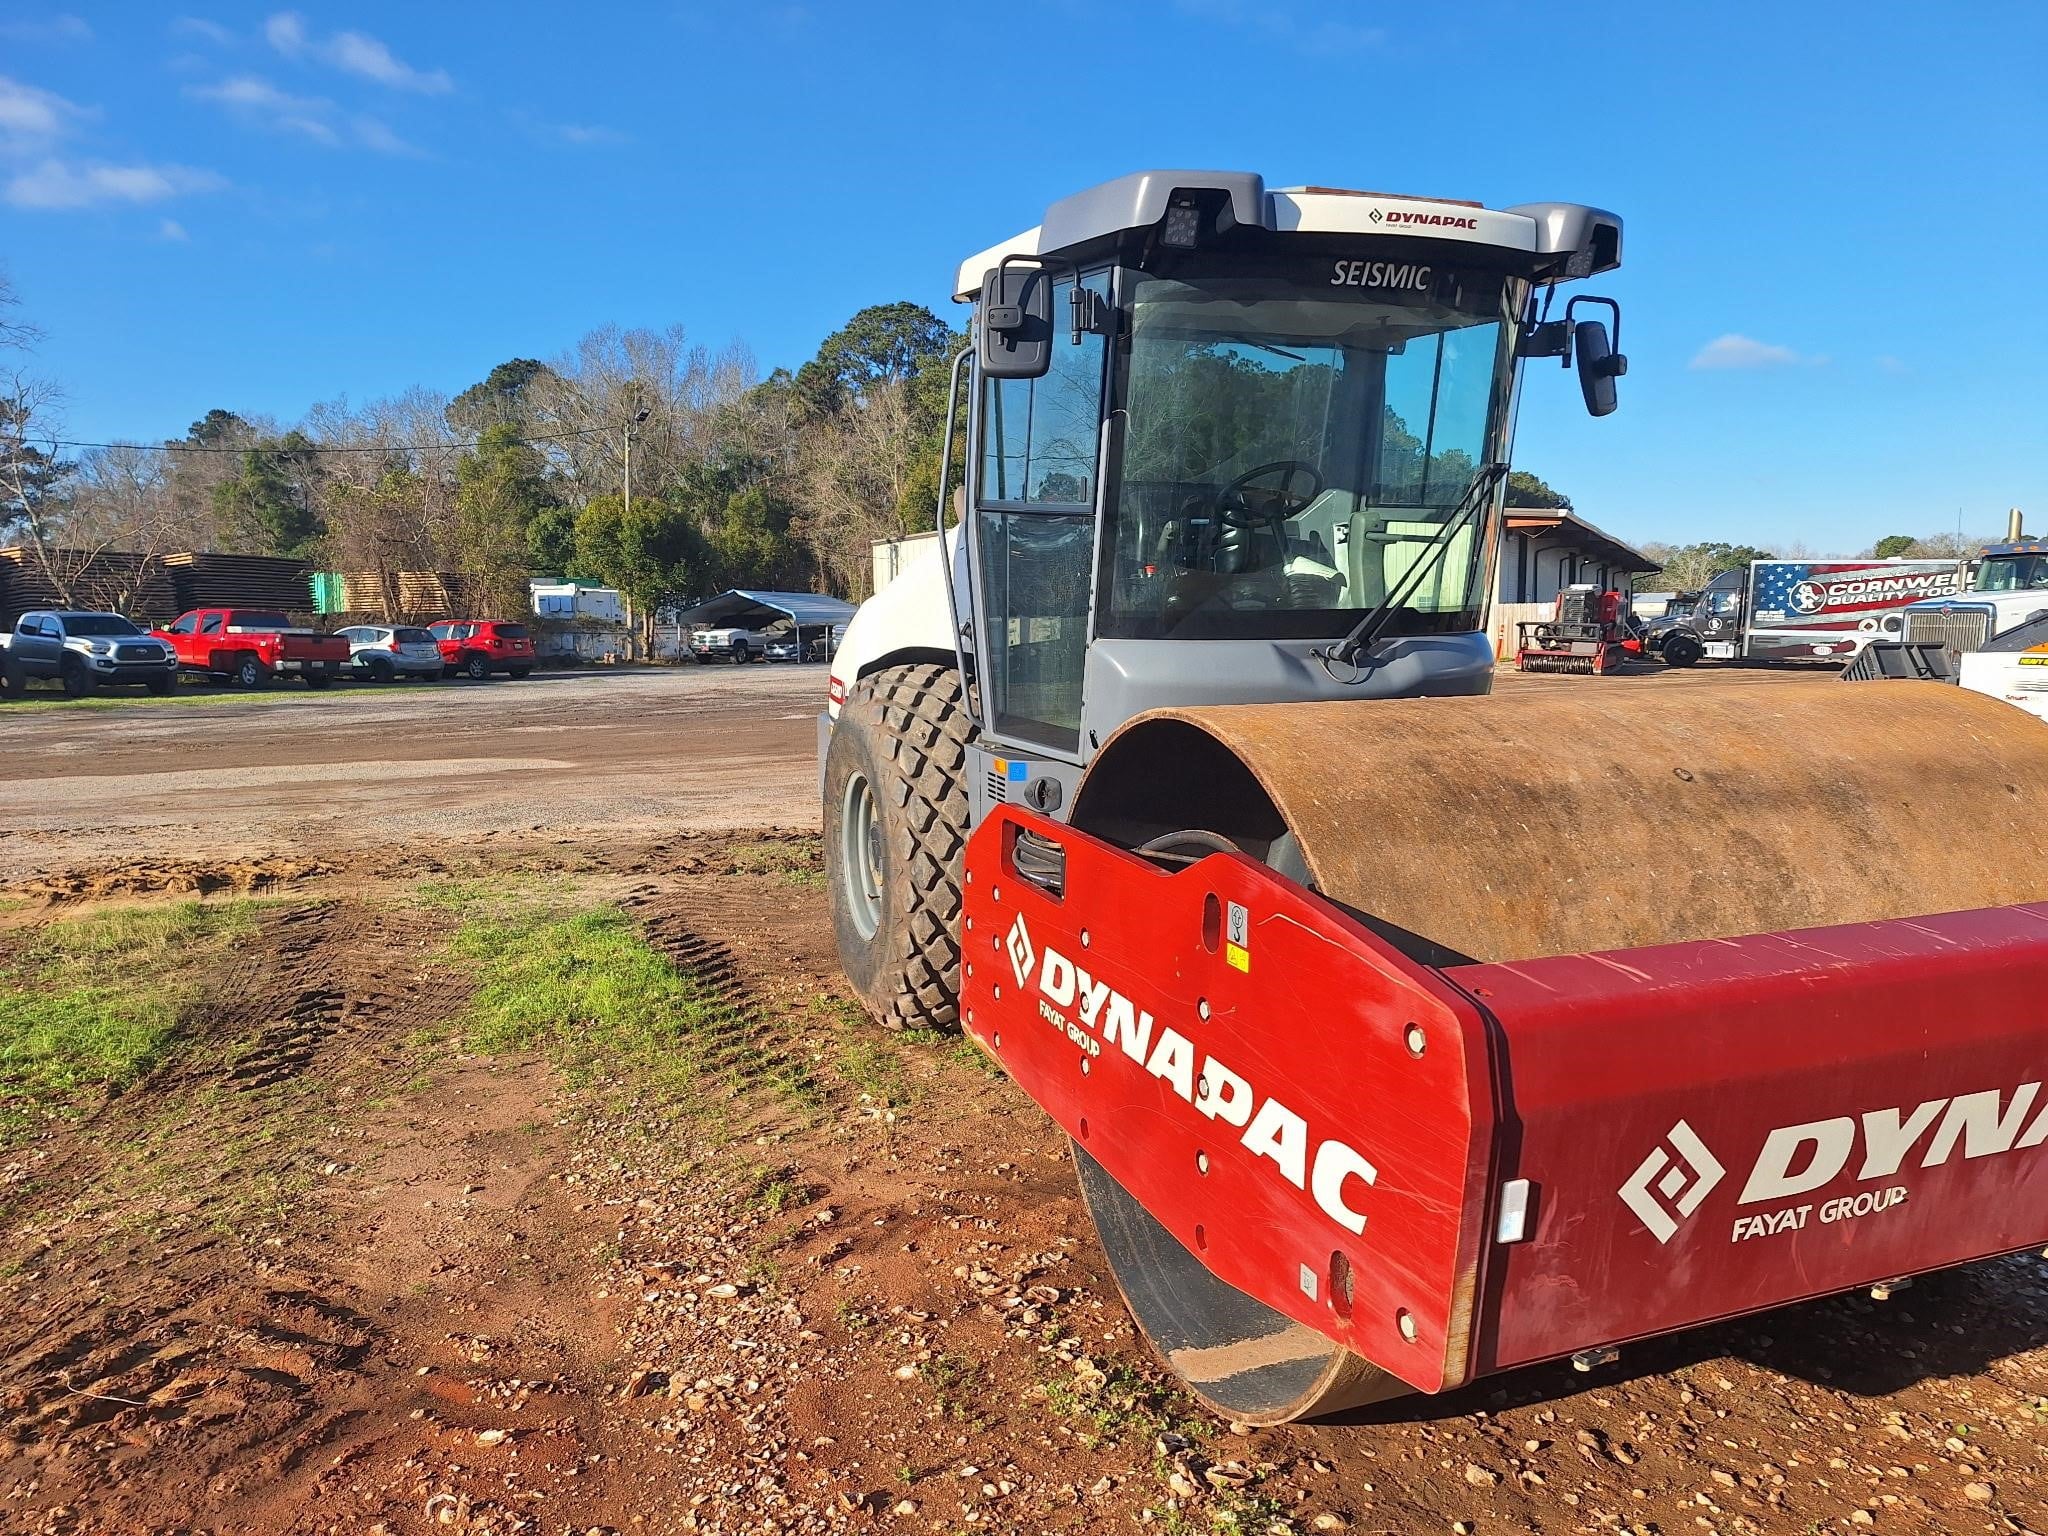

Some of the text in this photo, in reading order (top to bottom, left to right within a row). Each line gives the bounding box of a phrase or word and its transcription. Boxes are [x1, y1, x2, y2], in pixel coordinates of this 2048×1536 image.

[1386, 212, 1478, 229] DYNAPAC
[1330, 260, 1431, 290] SEISMIC
[1827, 591, 1908, 606] QUALITY
[1038, 1001, 1101, 1058] FAYAT GROUP
[1039, 946, 1378, 1235] DYNAPAC
[1731, 1186, 1909, 1243] FAYAT GROUP
